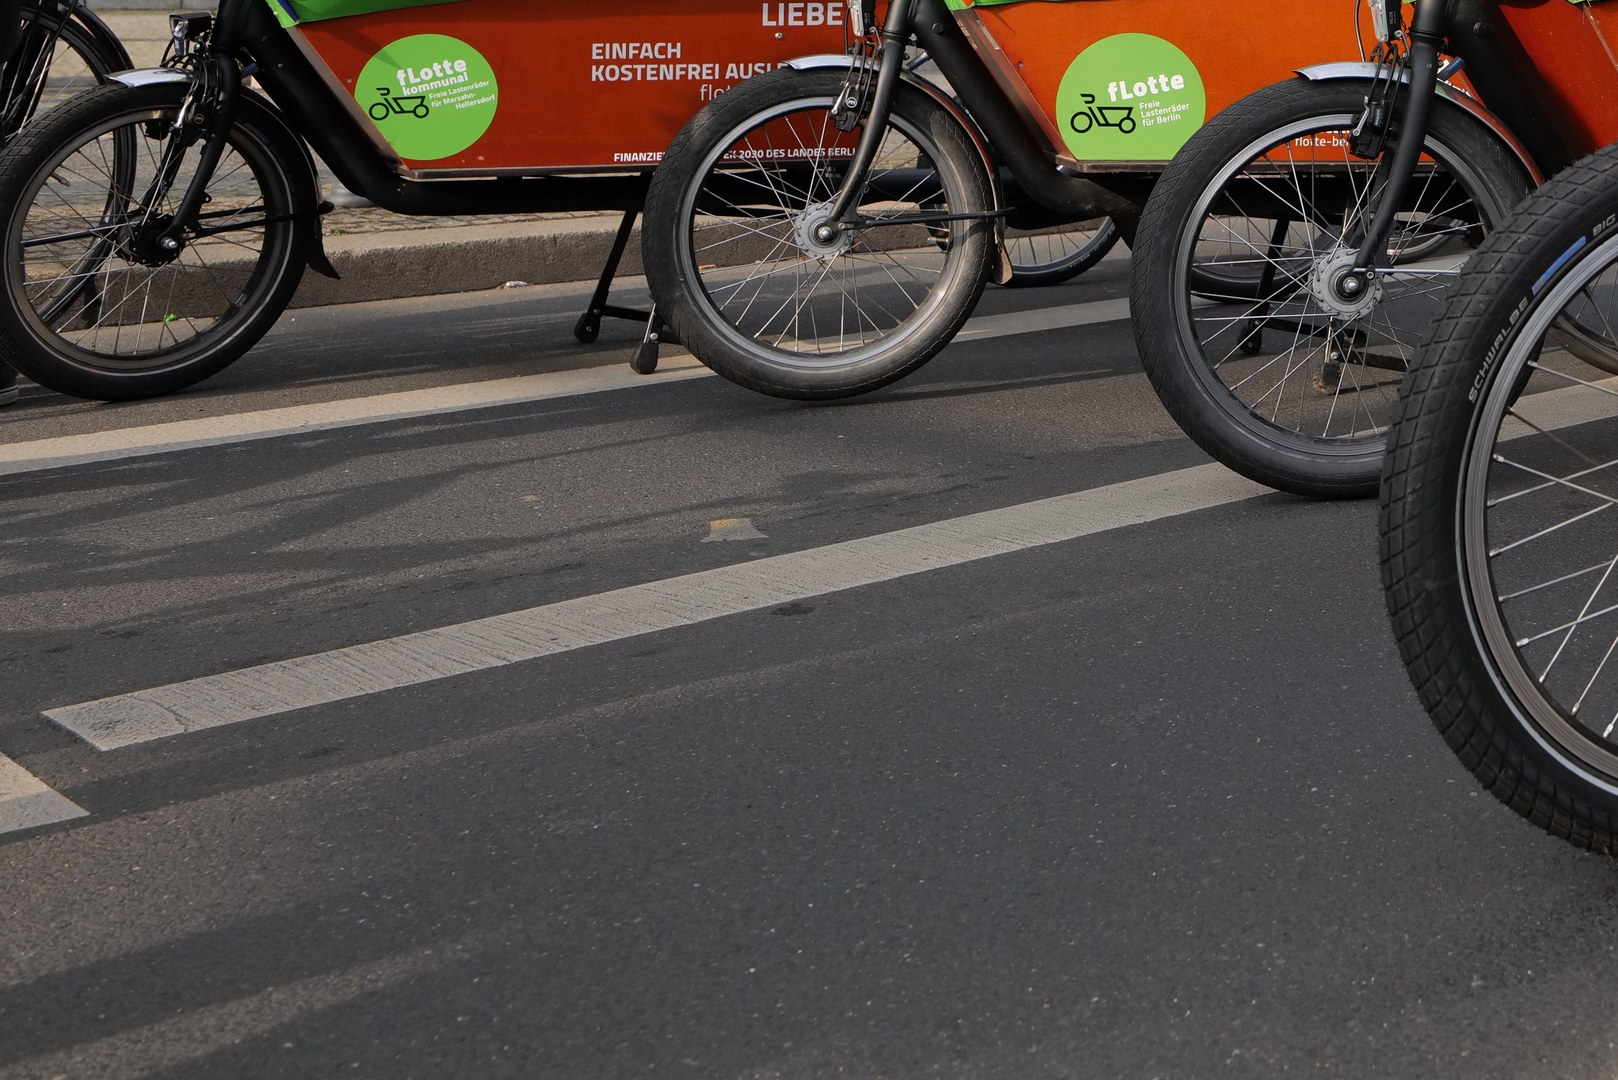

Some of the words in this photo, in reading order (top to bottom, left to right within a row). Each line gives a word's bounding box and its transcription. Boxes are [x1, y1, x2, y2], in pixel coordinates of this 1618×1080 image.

[591, 42, 681, 60] EINFACH
[396, 59, 467, 87] fLotte
[591, 62, 720, 82] KOSTENFREI
[401, 72, 469, 96] kommunal
[429, 90, 447, 100] Freie
[448, 80, 490, 96] Lastenräder
[1107, 73, 1185, 103] fLotte
[431, 100, 442, 108] für
[443, 93, 476, 105] Marzahn-
[455, 94, 496, 110] Hellersdorf
[1139, 100, 1160, 110] Freie
[1140, 102, 1190, 119] Lastenräder
[1142, 119, 1154, 127] für
[1156, 113, 1181, 124] Berlin
[613, 151, 666, 162] FINANZIE
[739, 149, 764, 159] 2030
[766, 149, 785, 158] DES
[788, 148, 826, 157] LANDES
[1592, 213, 1617, 238] BIG
[1468, 295, 1530, 405] SCHWALBE
